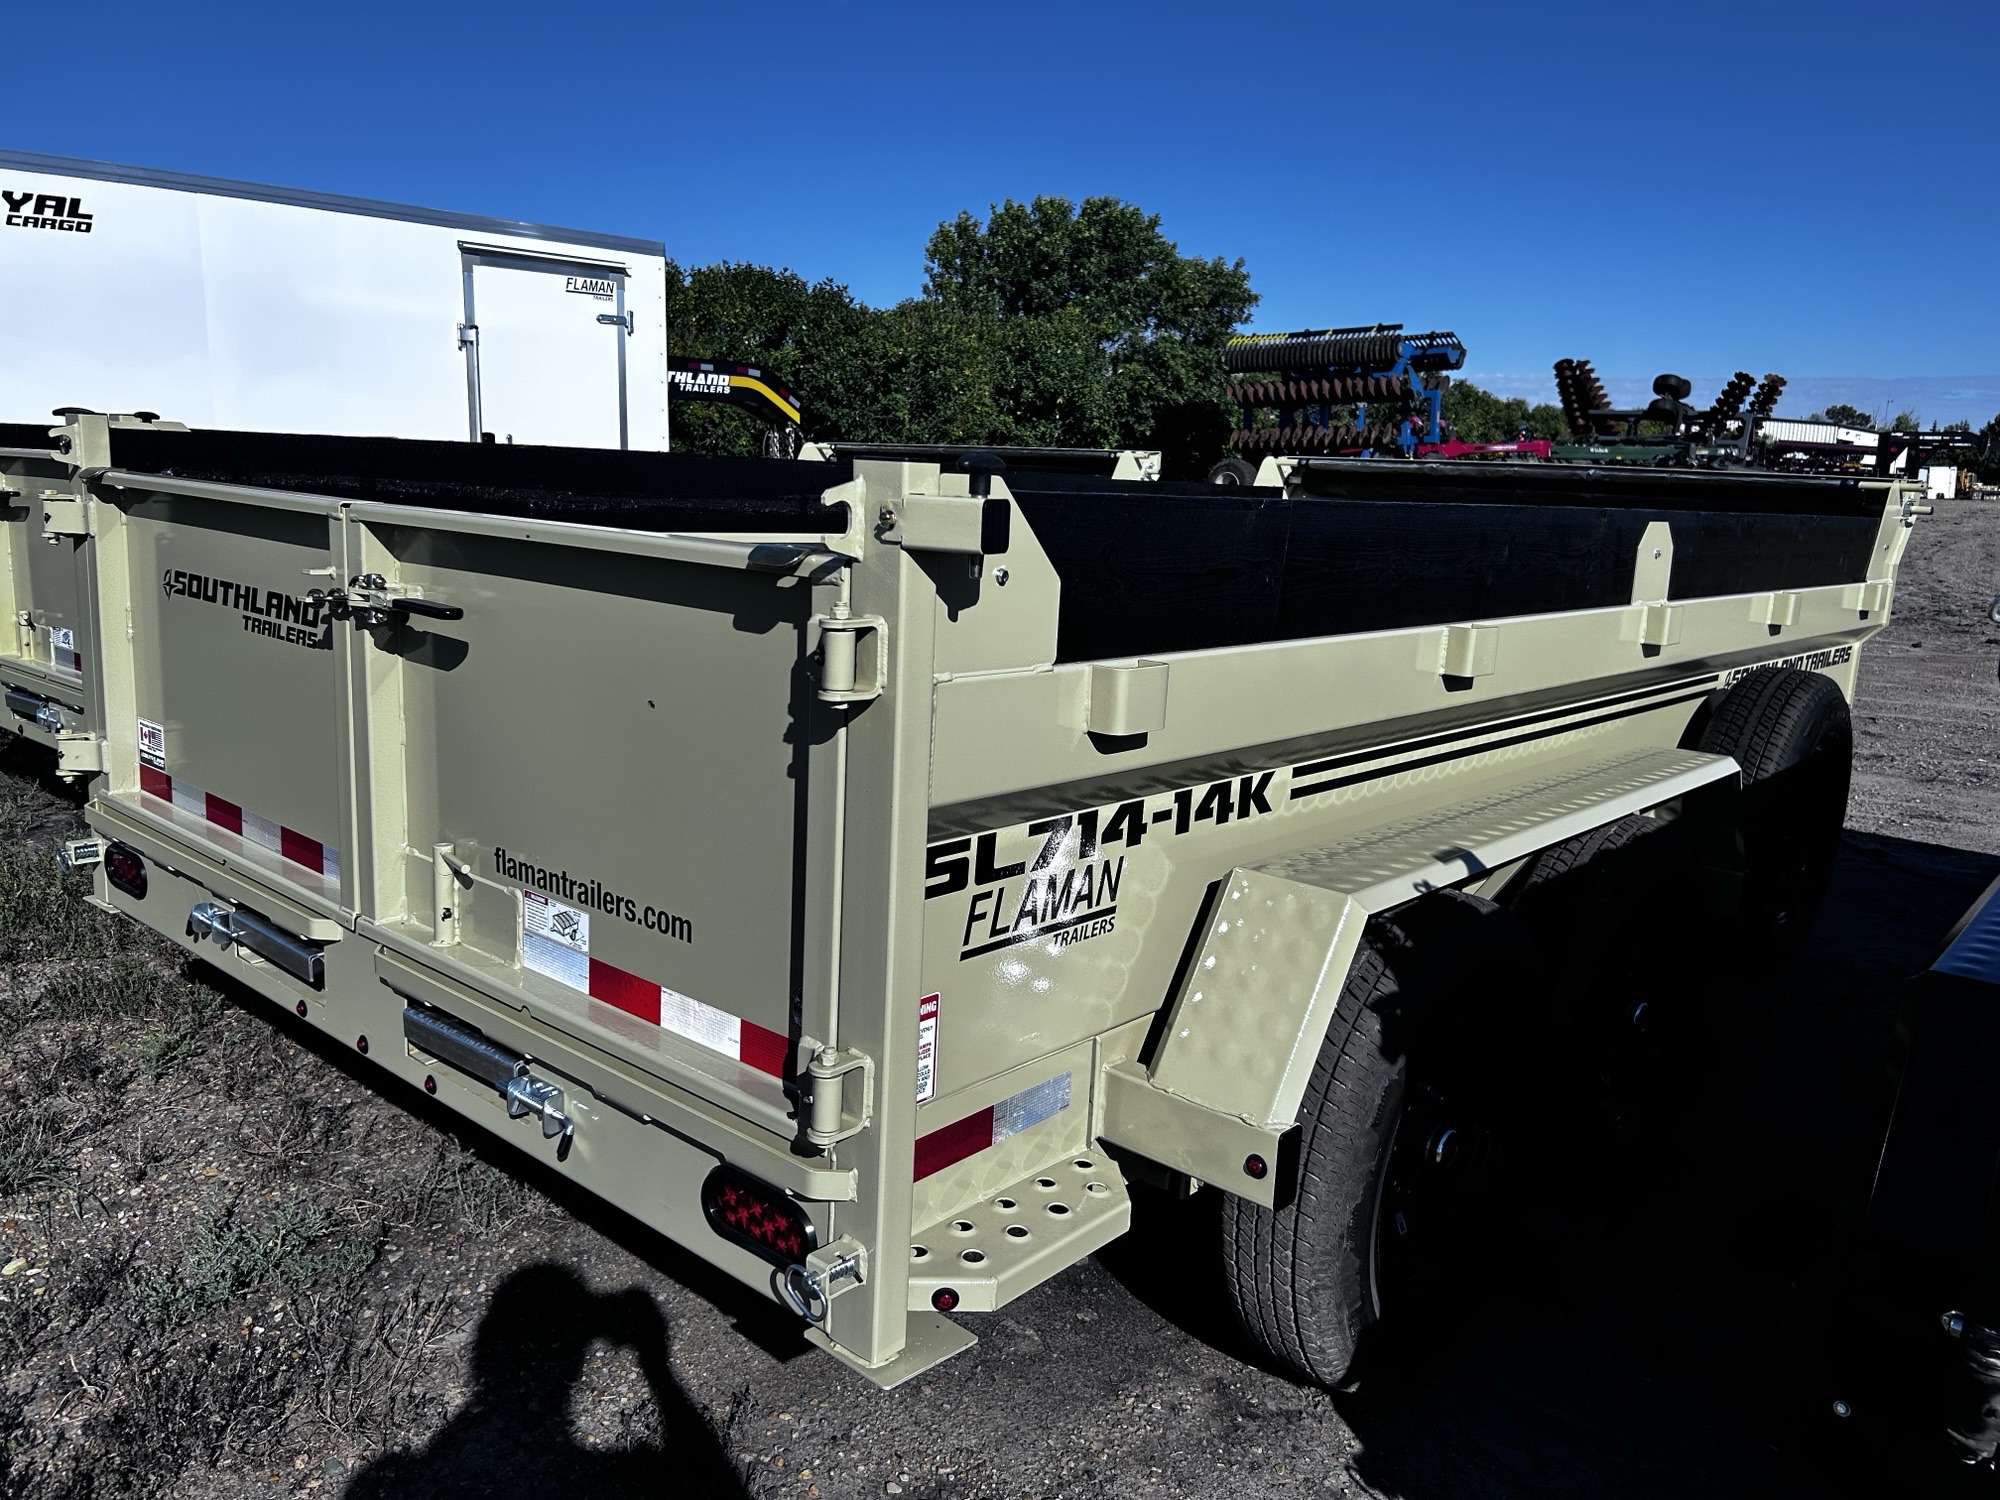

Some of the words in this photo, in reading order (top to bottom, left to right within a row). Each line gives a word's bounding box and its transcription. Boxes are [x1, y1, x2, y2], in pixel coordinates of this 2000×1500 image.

[1, 190, 93, 220] YAL
[6, 214, 92, 233] CARGO
[566, 277, 615, 294] FLAMAN
[679, 383, 731, 394] TRAILERS
[174, 570, 321, 628] SOUTHLAND
[242, 614, 319, 650] TRAILERS
[494, 846, 693, 945] flamantrailers.com
[963, 855, 1124, 947] FLAMAN
[1053, 916, 1116, 948] TRAILERS
